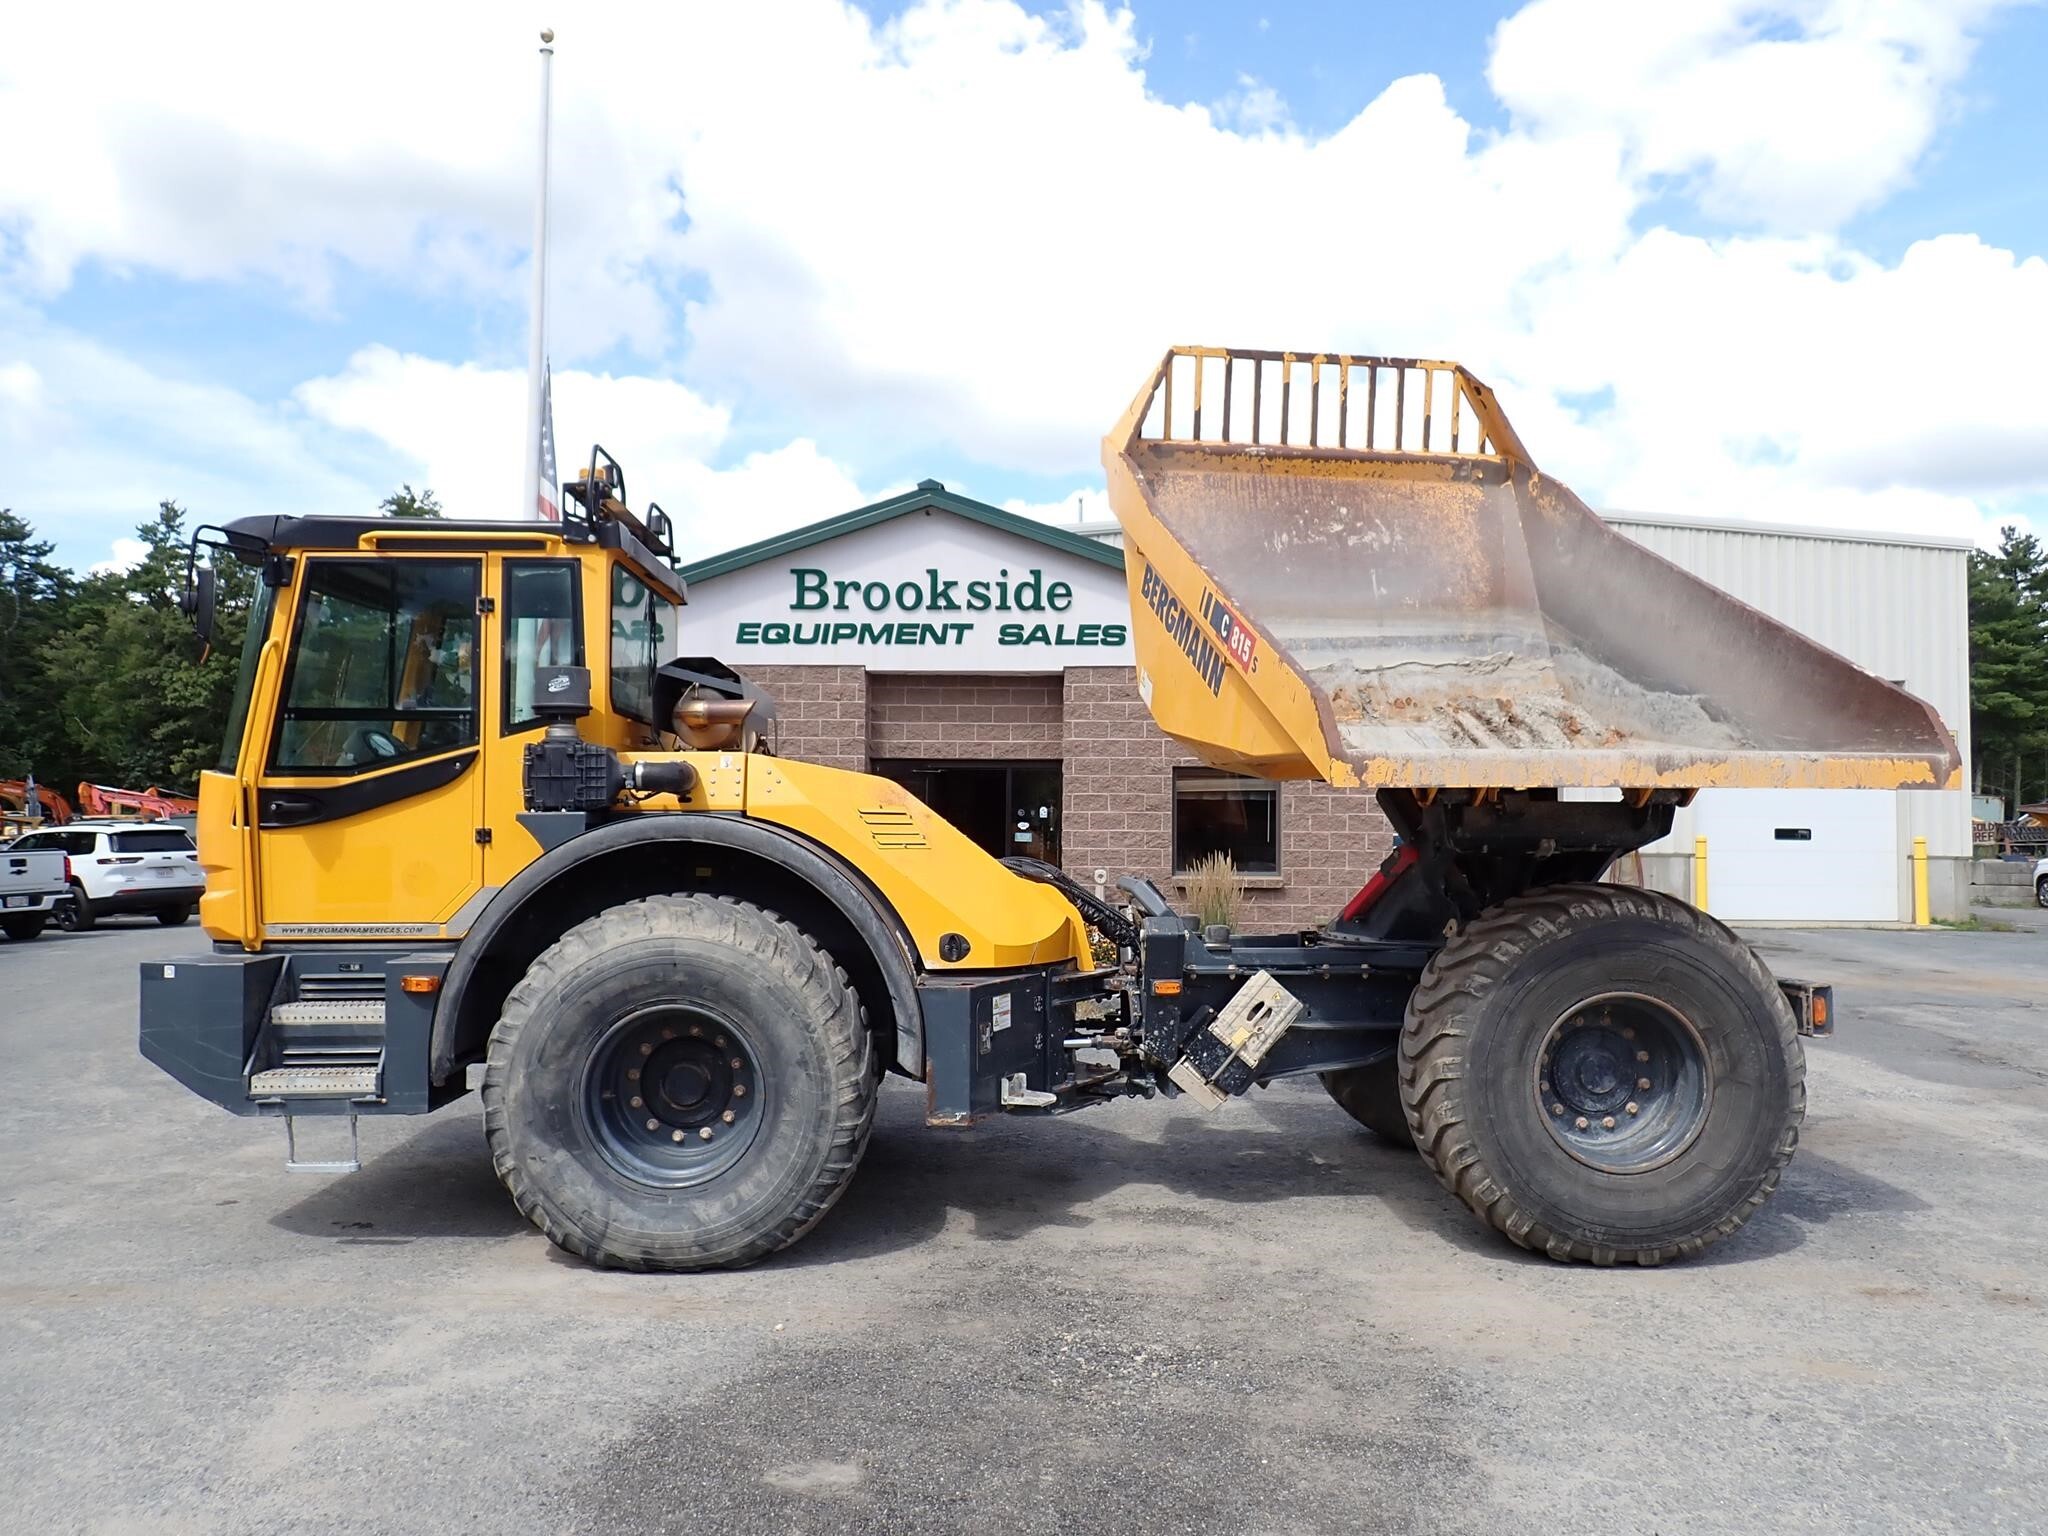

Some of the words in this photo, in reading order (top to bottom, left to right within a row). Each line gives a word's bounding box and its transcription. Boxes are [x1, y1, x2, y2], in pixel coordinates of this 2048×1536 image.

[789, 568, 1073, 612] Brookside
[736, 622, 974, 645] EQUIPMENT
[998, 624, 1128, 646] SALES
[1141, 563, 1226, 698] BERGMANN
